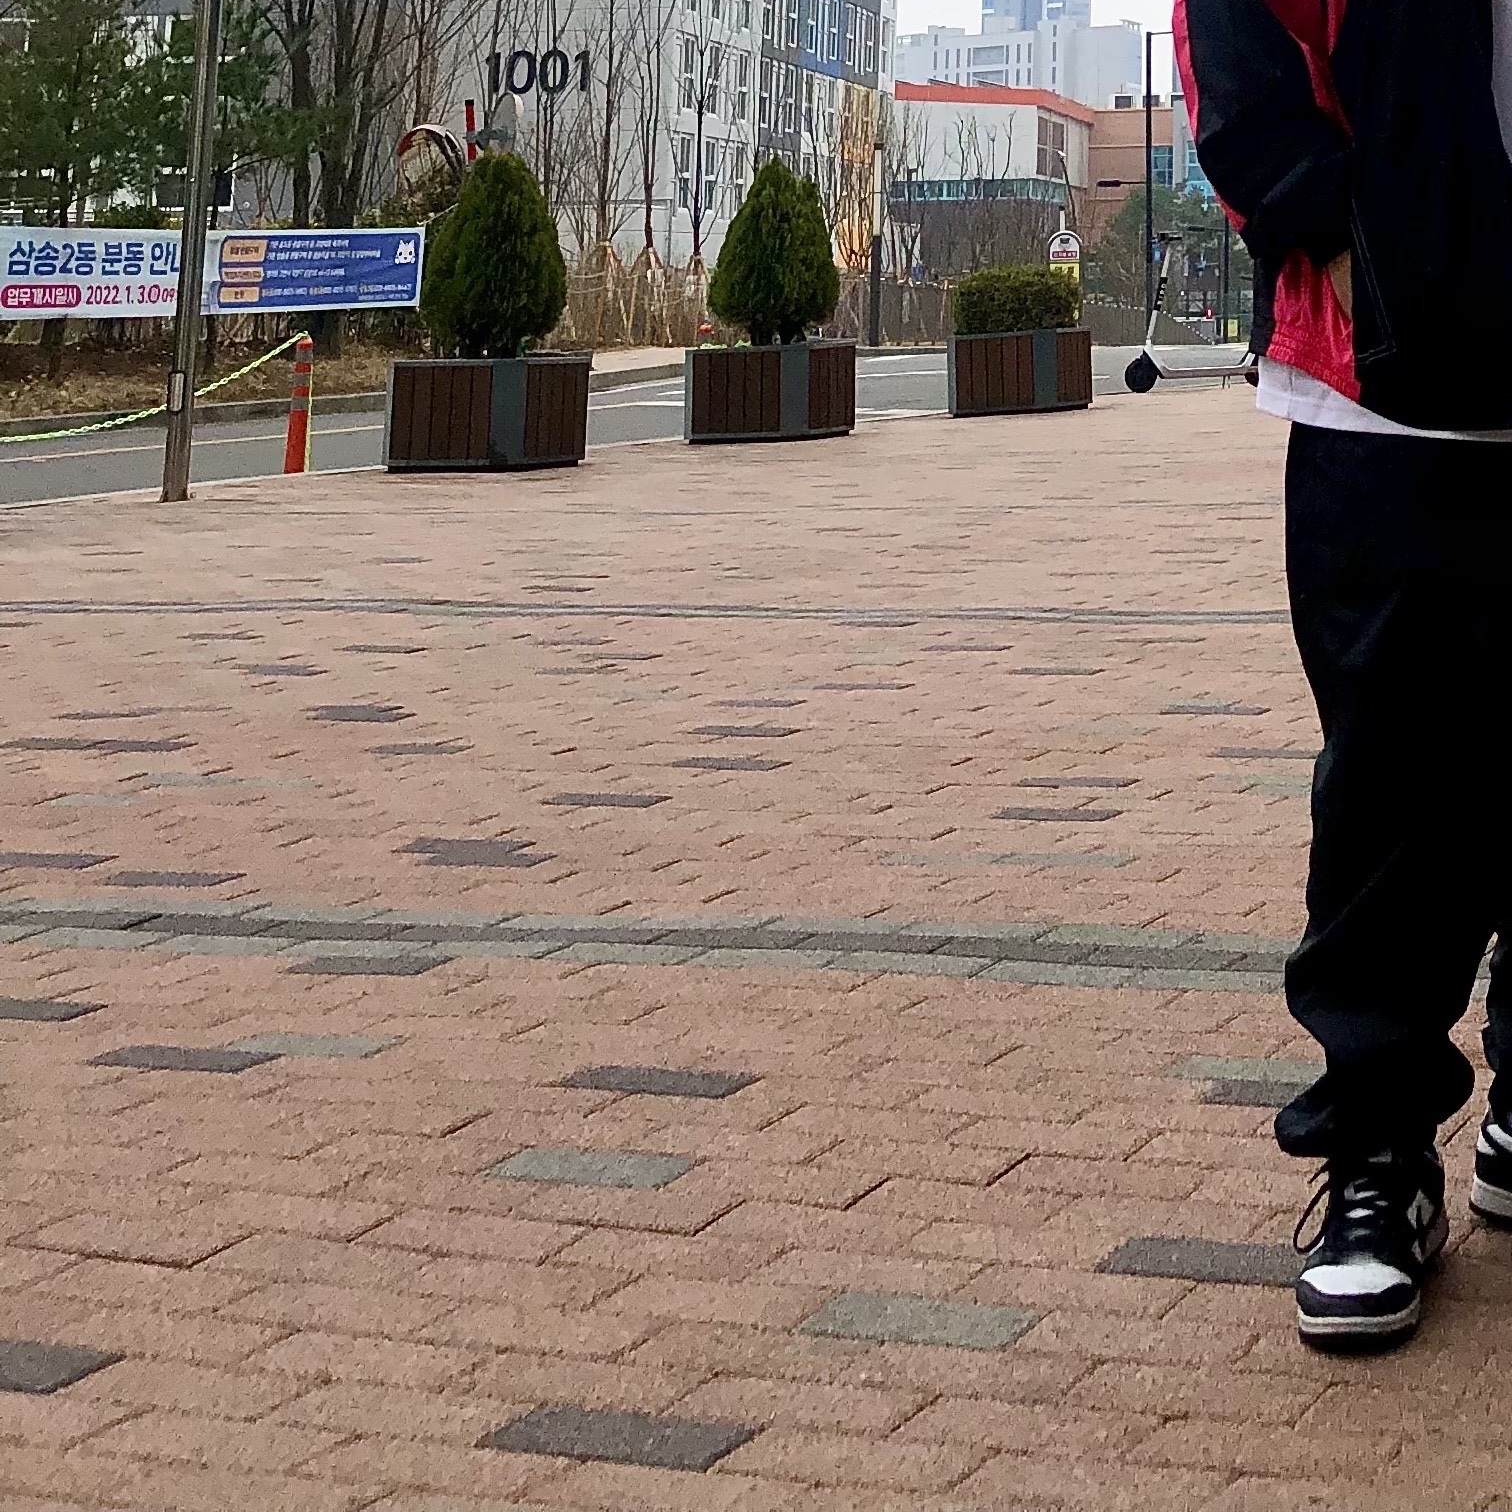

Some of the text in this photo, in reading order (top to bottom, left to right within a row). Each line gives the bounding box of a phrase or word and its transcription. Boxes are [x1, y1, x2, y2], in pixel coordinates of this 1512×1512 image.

[485, 49, 591, 94] 1001
[7, 240, 97, 276] 삼송2동
[101, 242, 145, 276] 분동
